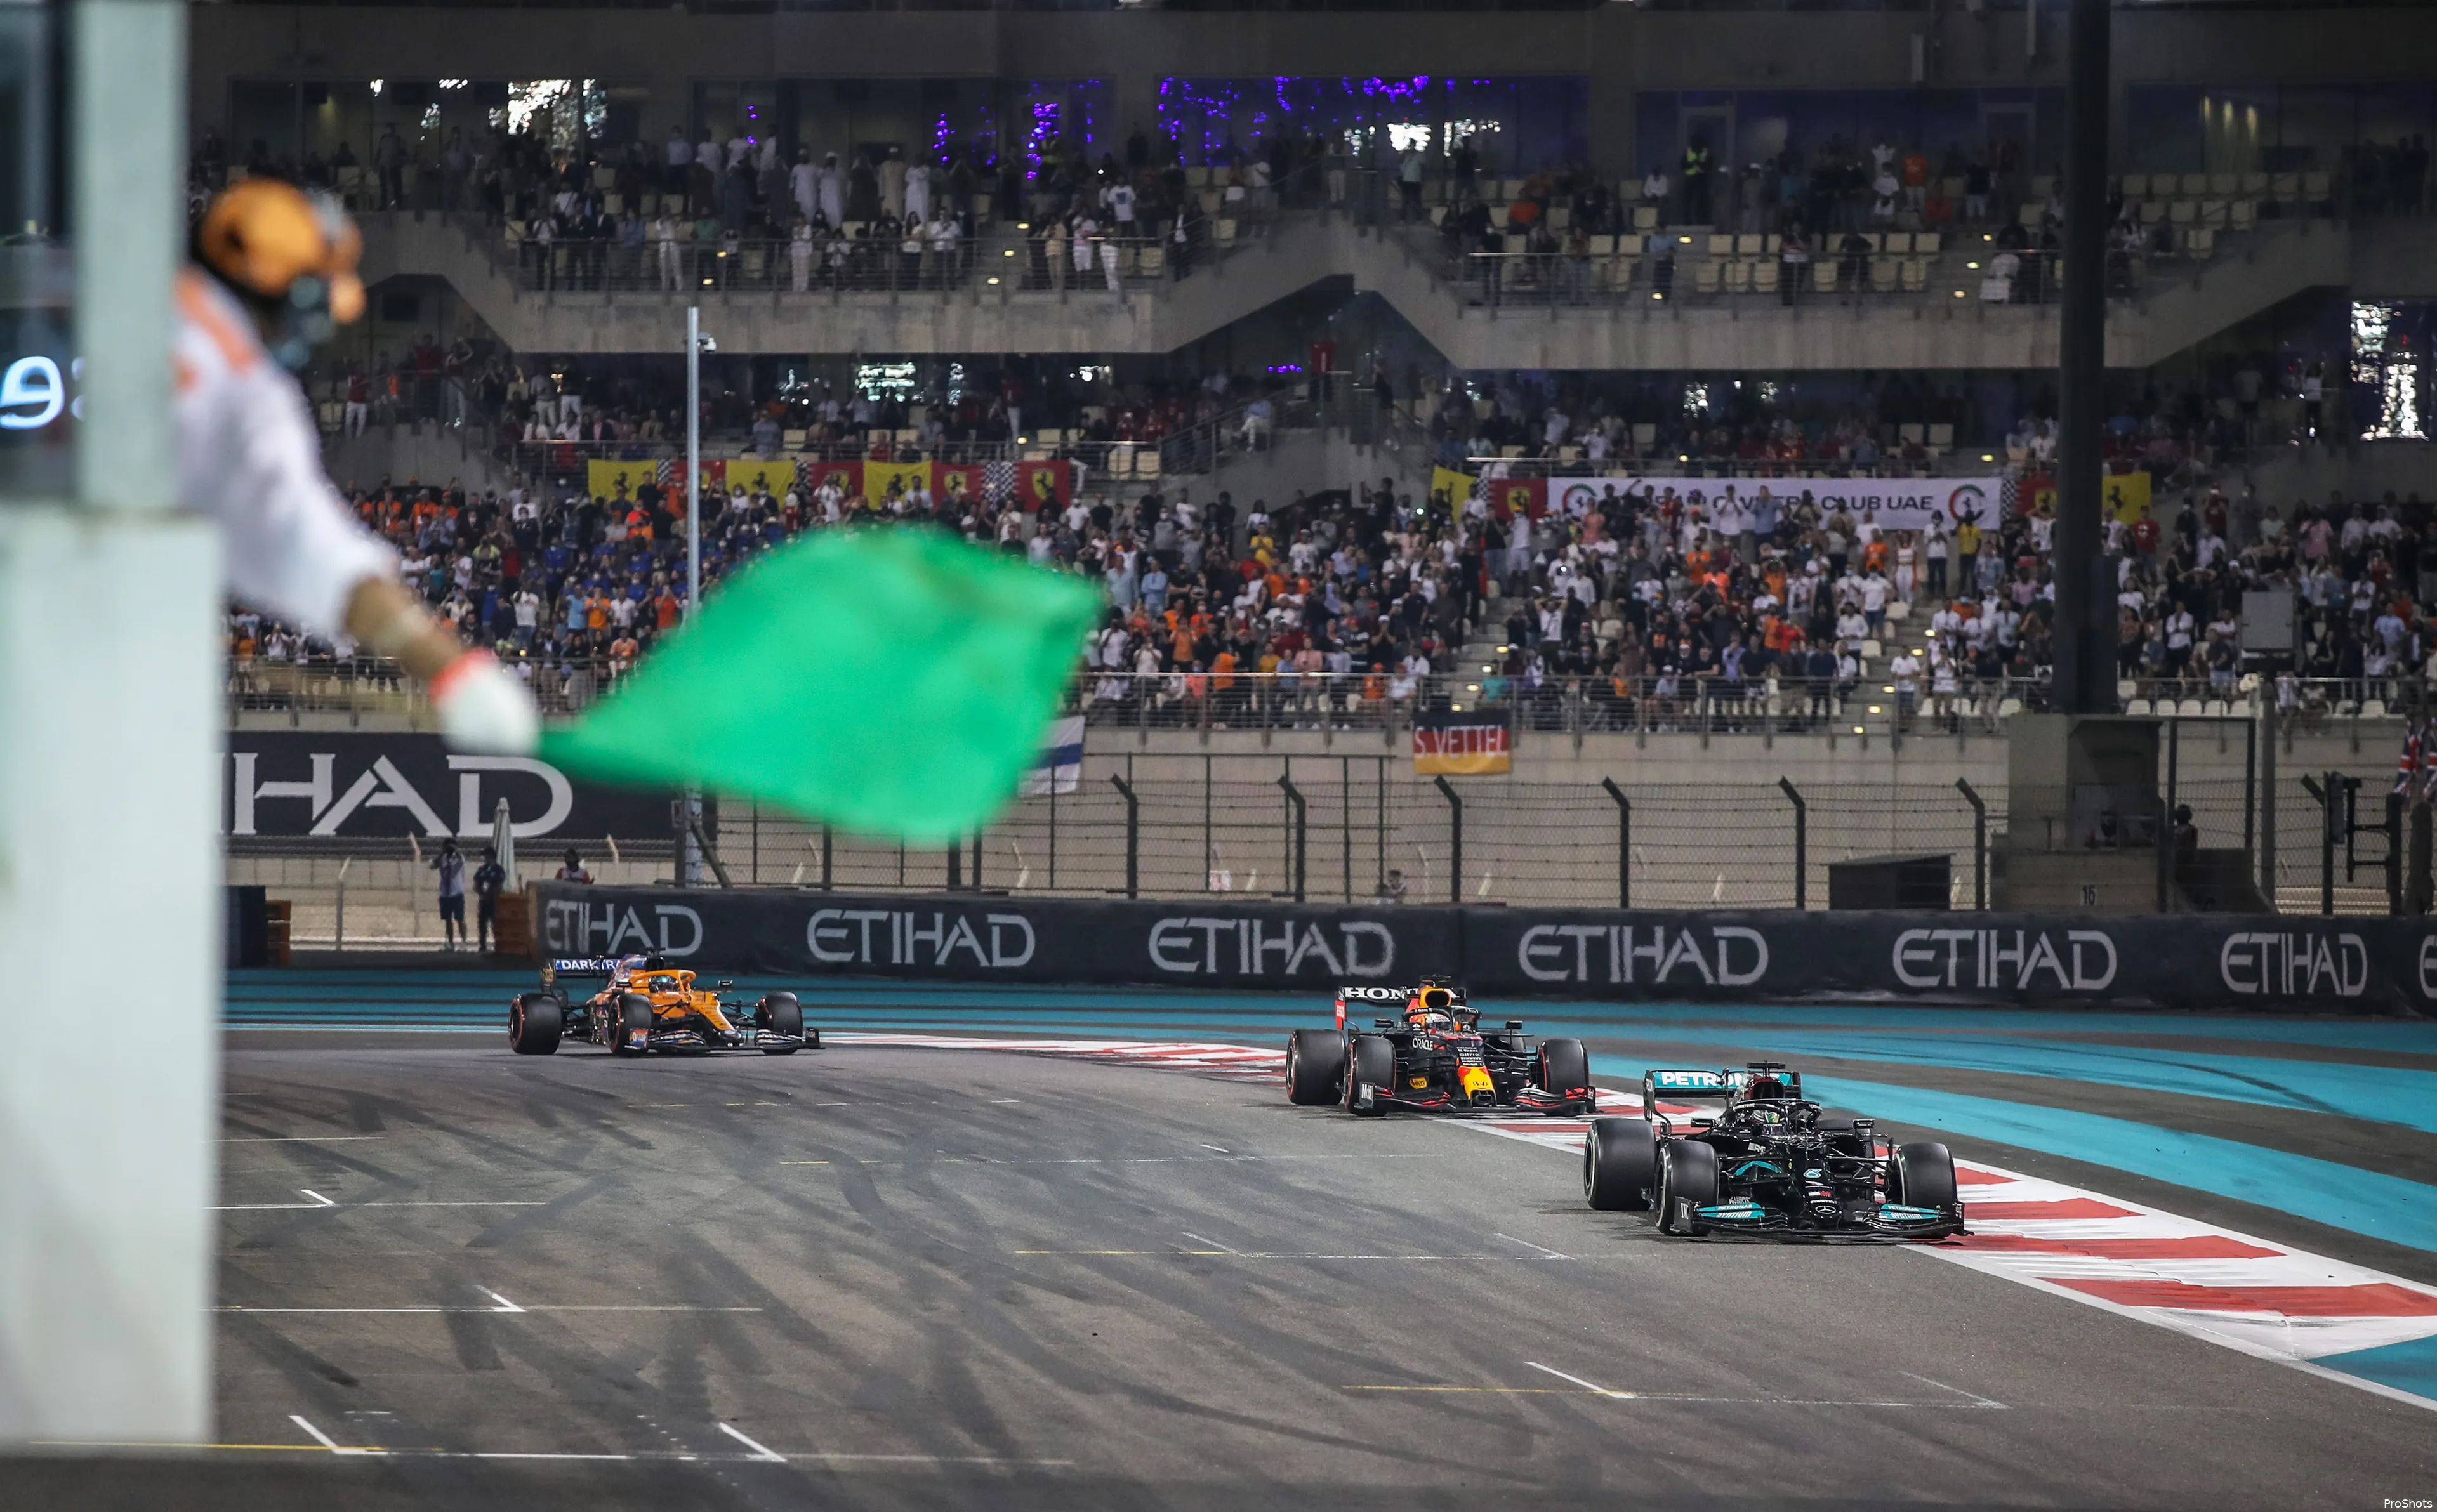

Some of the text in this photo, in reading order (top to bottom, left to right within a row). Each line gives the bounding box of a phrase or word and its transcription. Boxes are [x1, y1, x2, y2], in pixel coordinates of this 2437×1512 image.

[1821, 496, 1881, 510] CUB
[1887, 496, 1934, 510] UAE
[546, 899, 703, 957] ETIHAD
[807, 909, 1036, 967] ETIHAD
[1148, 917, 1394, 977] ETIHAD
[1518, 924, 1769, 985] ETIHAD
[1892, 928, 2117, 990] ETIHAD
[2221, 932, 2367, 996] ETIHAD
[1412, 1037, 1434, 1051] ORACLE
[1661, 1072, 1780, 1086] PETRON
